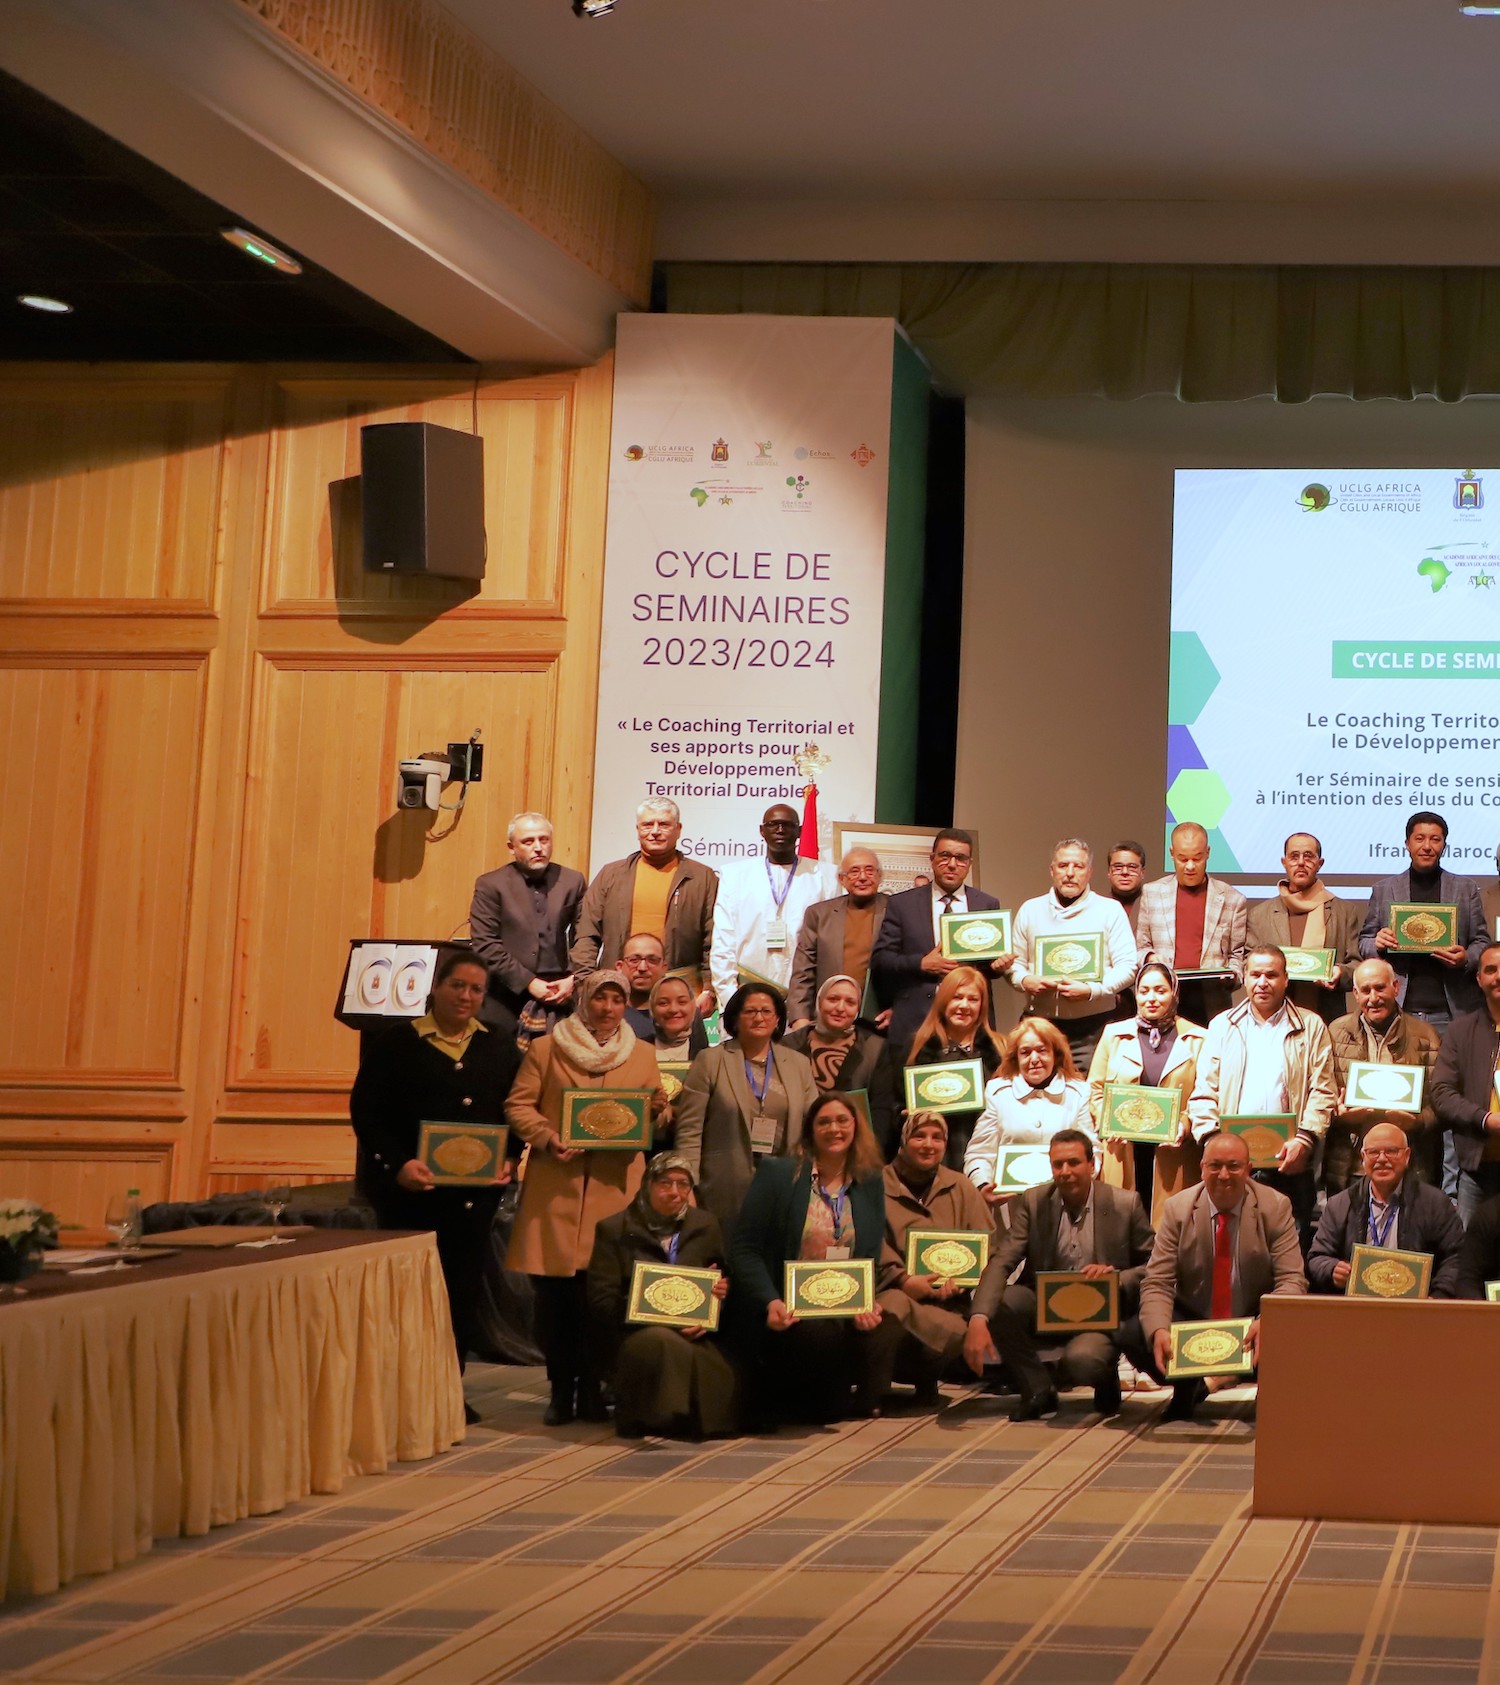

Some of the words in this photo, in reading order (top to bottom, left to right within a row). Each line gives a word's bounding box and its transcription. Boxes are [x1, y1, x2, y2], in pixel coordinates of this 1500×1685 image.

[1340, 484, 1372, 492] UCLG
[1376, 484, 1421, 492] AFRICA
[1340, 503, 1370, 512] CGLU
[1373, 503, 1421, 513] AFRIQUE
[656, 551, 771, 579] CYCLE
[787, 553, 830, 580] DE
[1468, 576, 1496, 585] ALGA
[633, 594, 849, 624] SEMINAIRES
[643, 638, 835, 670] 2023/2024
[1352, 652, 1414, 668] CYCLE
[1421, 653, 1446, 668] DE
[618, 721, 626, 729] «
[633, 718, 652, 731] Le
[659, 718, 741, 736] Coaching
[747, 720, 832, 734] Territorial
[838, 722, 854, 734] et
[1308, 713, 1328, 727] Le
[1336, 713, 1425, 732] Coaching
[1332, 733, 1348, 748] le
[651, 743, 680, 753] ses
[686, 742, 753, 757] apports
[759, 744, 800, 757] pour
[665, 760, 803, 779] Développement
[1296, 773, 1324, 786] 1er
[1330, 772, 1421, 786] Séminaire
[1428, 773, 1449, 787] de
[646, 782, 731, 797] Territorial
[737, 783, 805, 798] Durable
[1256, 790, 1265, 804] à
[1273, 791, 1365, 805] l’intention
[1372, 791, 1402, 805] des
[1409, 791, 1445, 806] élus
[1452, 792, 1473, 806] du
[681, 837, 764, 856] Séminai
[1369, 844, 1408, 857] Ifran
[661, 1287, 688, 1303] شهادة
[817, 1281, 844, 1296] شهادة
